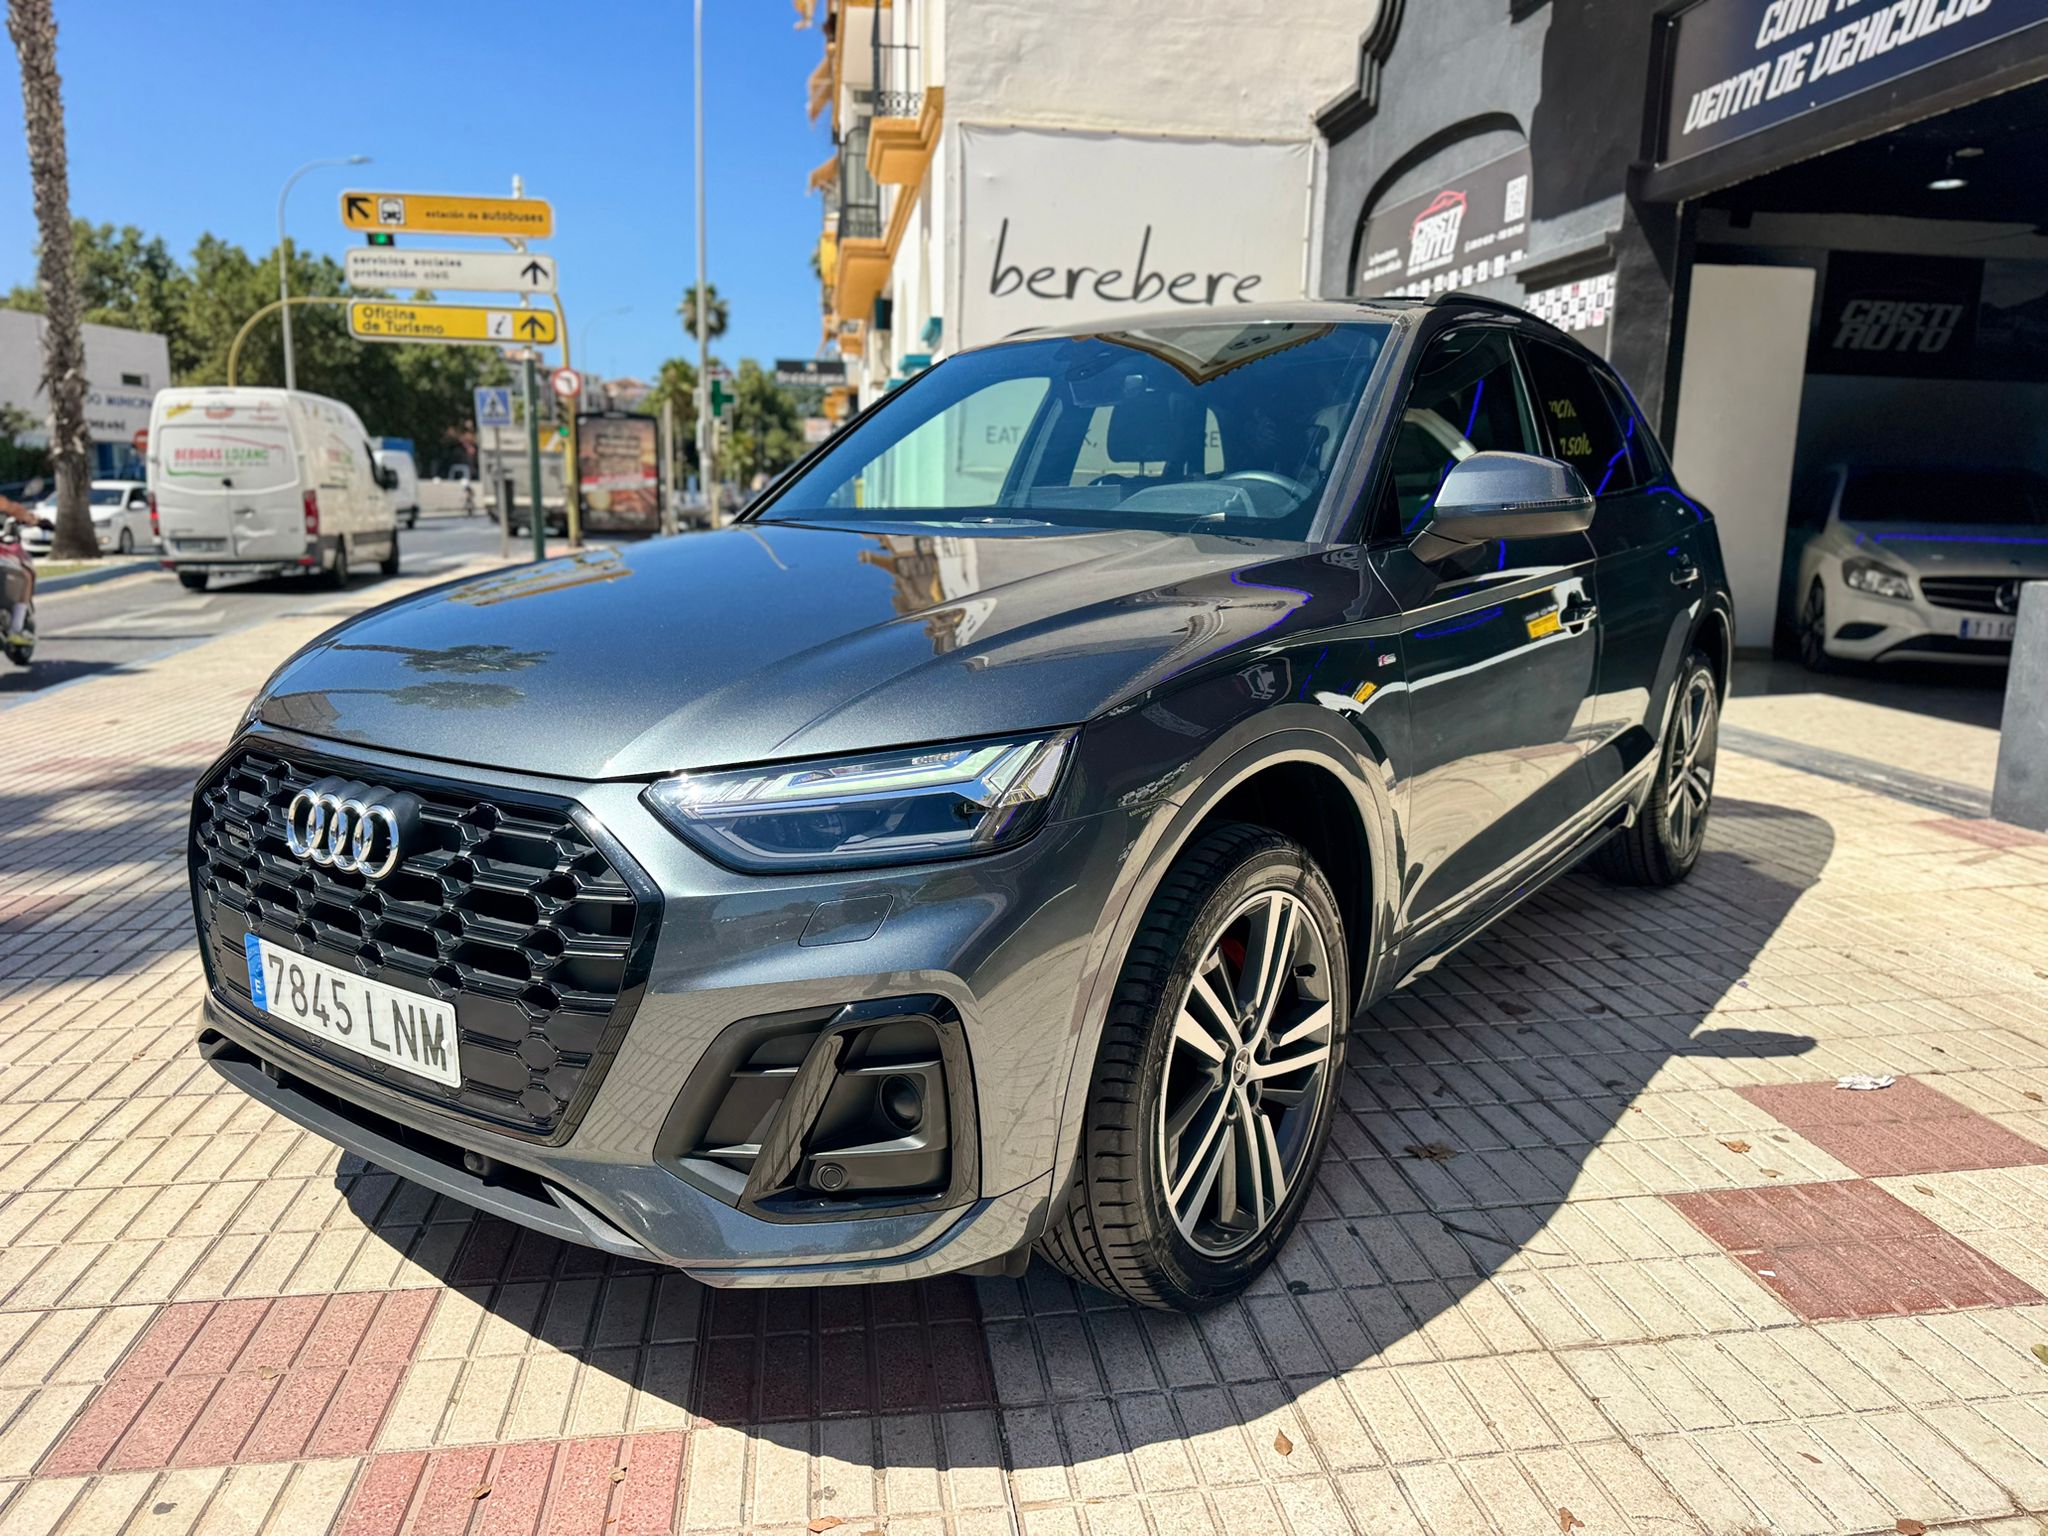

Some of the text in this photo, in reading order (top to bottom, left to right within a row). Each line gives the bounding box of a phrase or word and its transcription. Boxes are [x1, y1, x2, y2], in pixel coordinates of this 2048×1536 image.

[1683, 61, 1771, 135] VENTA
[1766, 41, 1814, 100] DE
[467, 212, 478, 220] de
[482, 211, 545, 222] autobuses
[1408, 227, 1460, 267] AUTO
[353, 257, 462, 267] servicios sociales
[990, 217, 1261, 305] berebere
[353, 269, 450, 280] protección civil
[362, 306, 416, 320] Oficina
[1840, 300, 1963, 327] CRISTI
[362, 319, 444, 335] de Turismo
[1832, 323, 1952, 352] AUTO
[174, 448, 222, 460] BEBIDAS
[268, 953, 447, 1072] 7845 LNM
